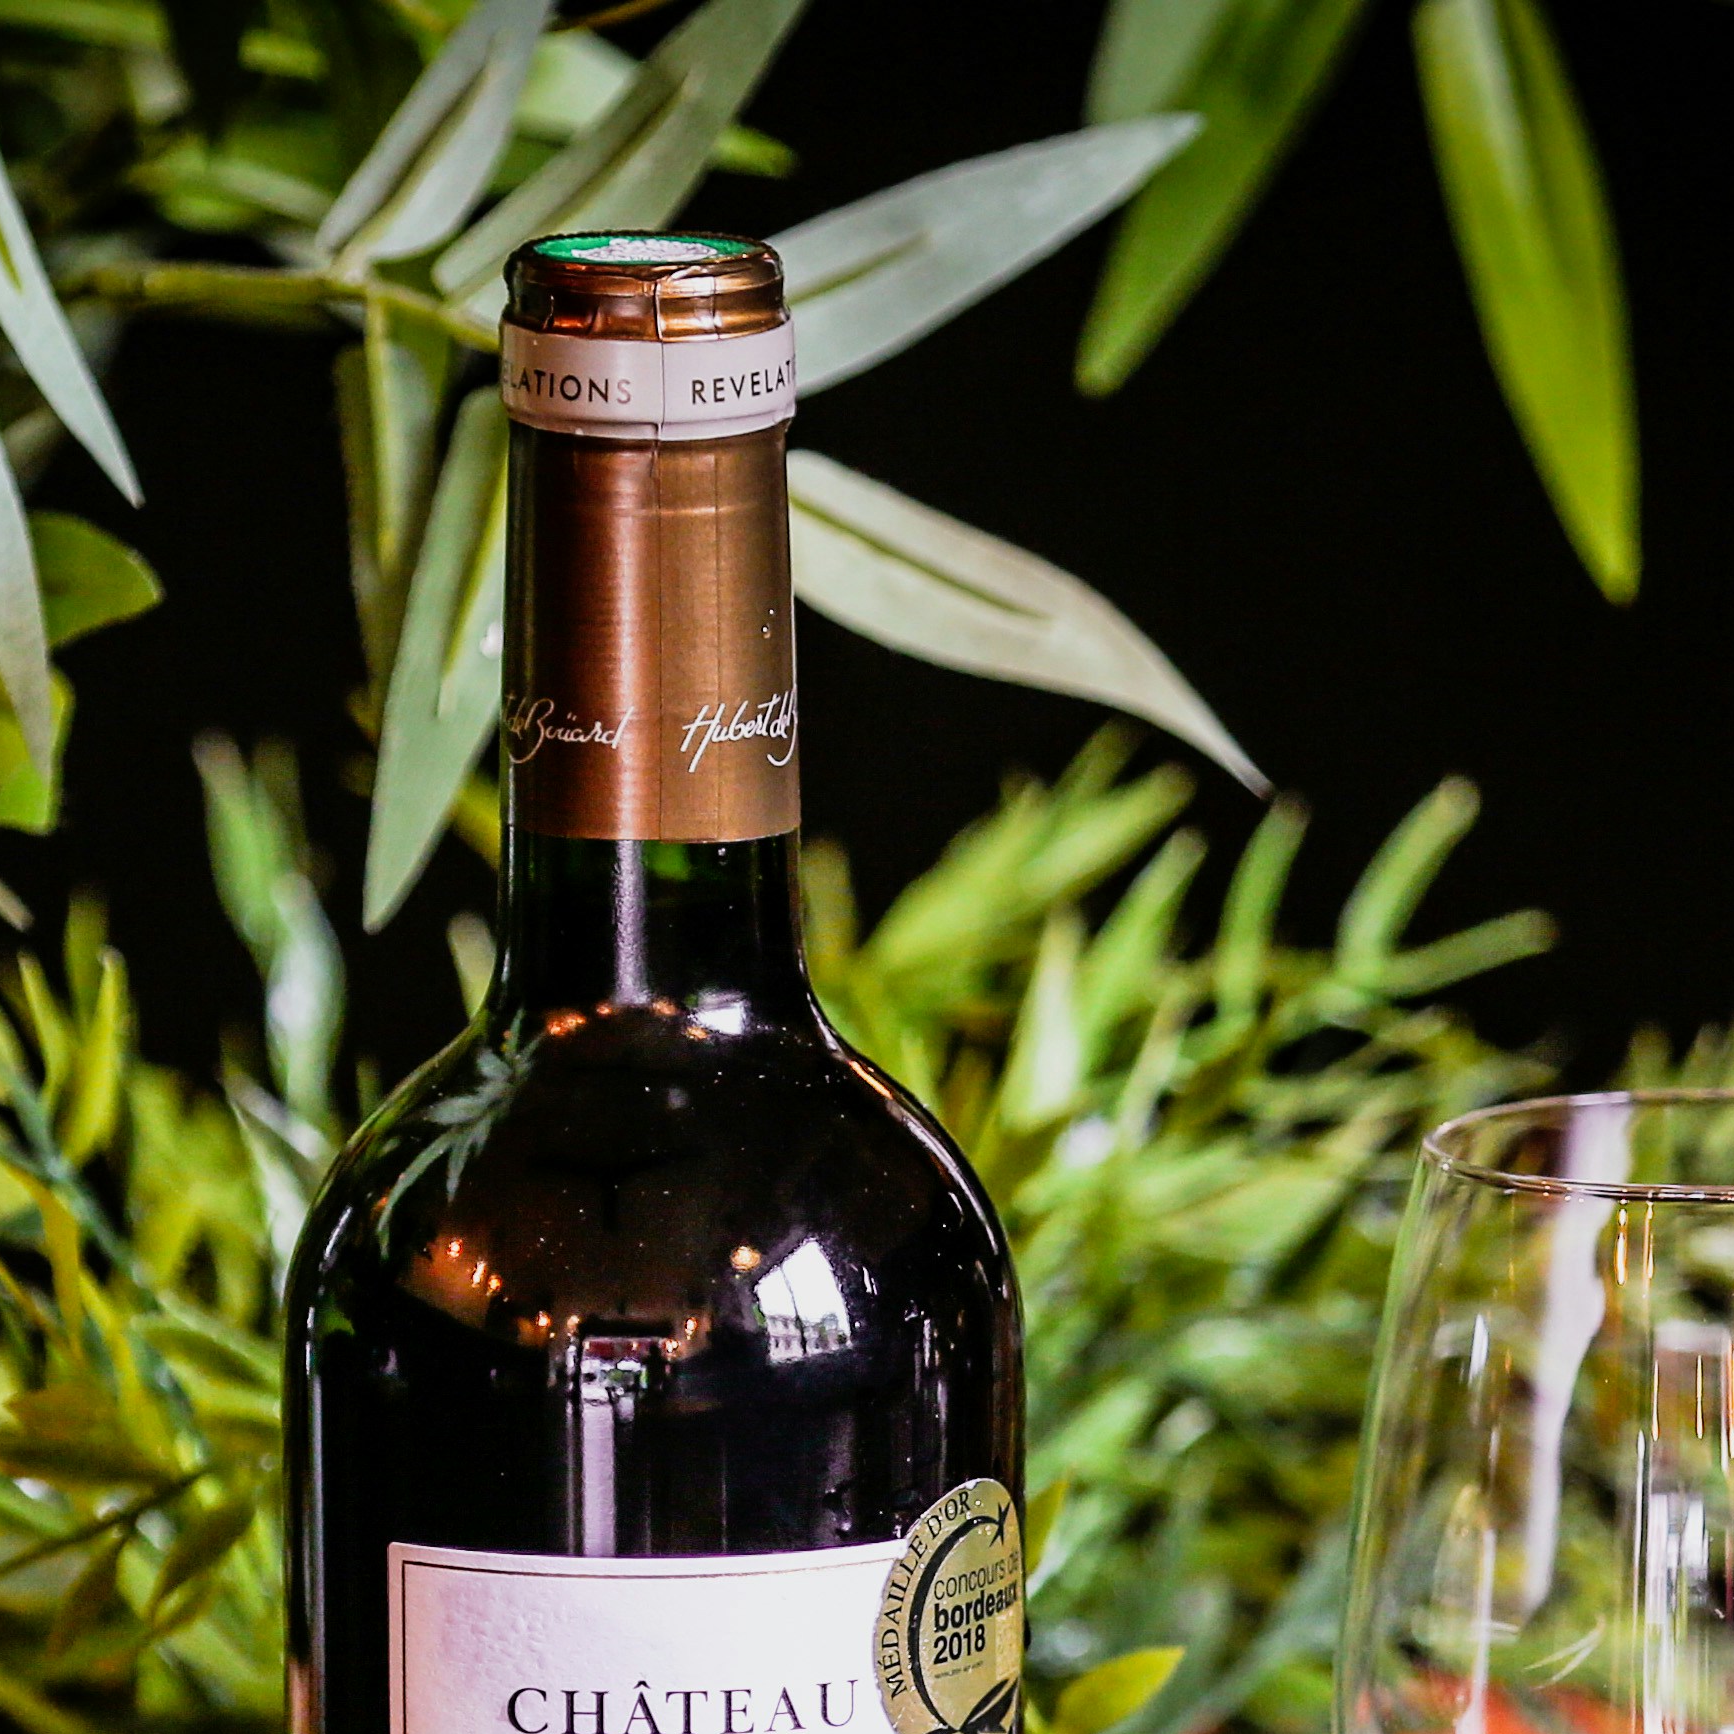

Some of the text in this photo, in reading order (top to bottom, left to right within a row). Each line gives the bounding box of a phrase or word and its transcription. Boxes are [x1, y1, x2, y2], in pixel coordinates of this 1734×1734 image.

[681, 693, 782, 773] Hubert
[877, 1490, 972, 1701] MÉDAILLE D'OR
[933, 1558, 1005, 1601] concours
[933, 1624, 986, 1665] 2018
